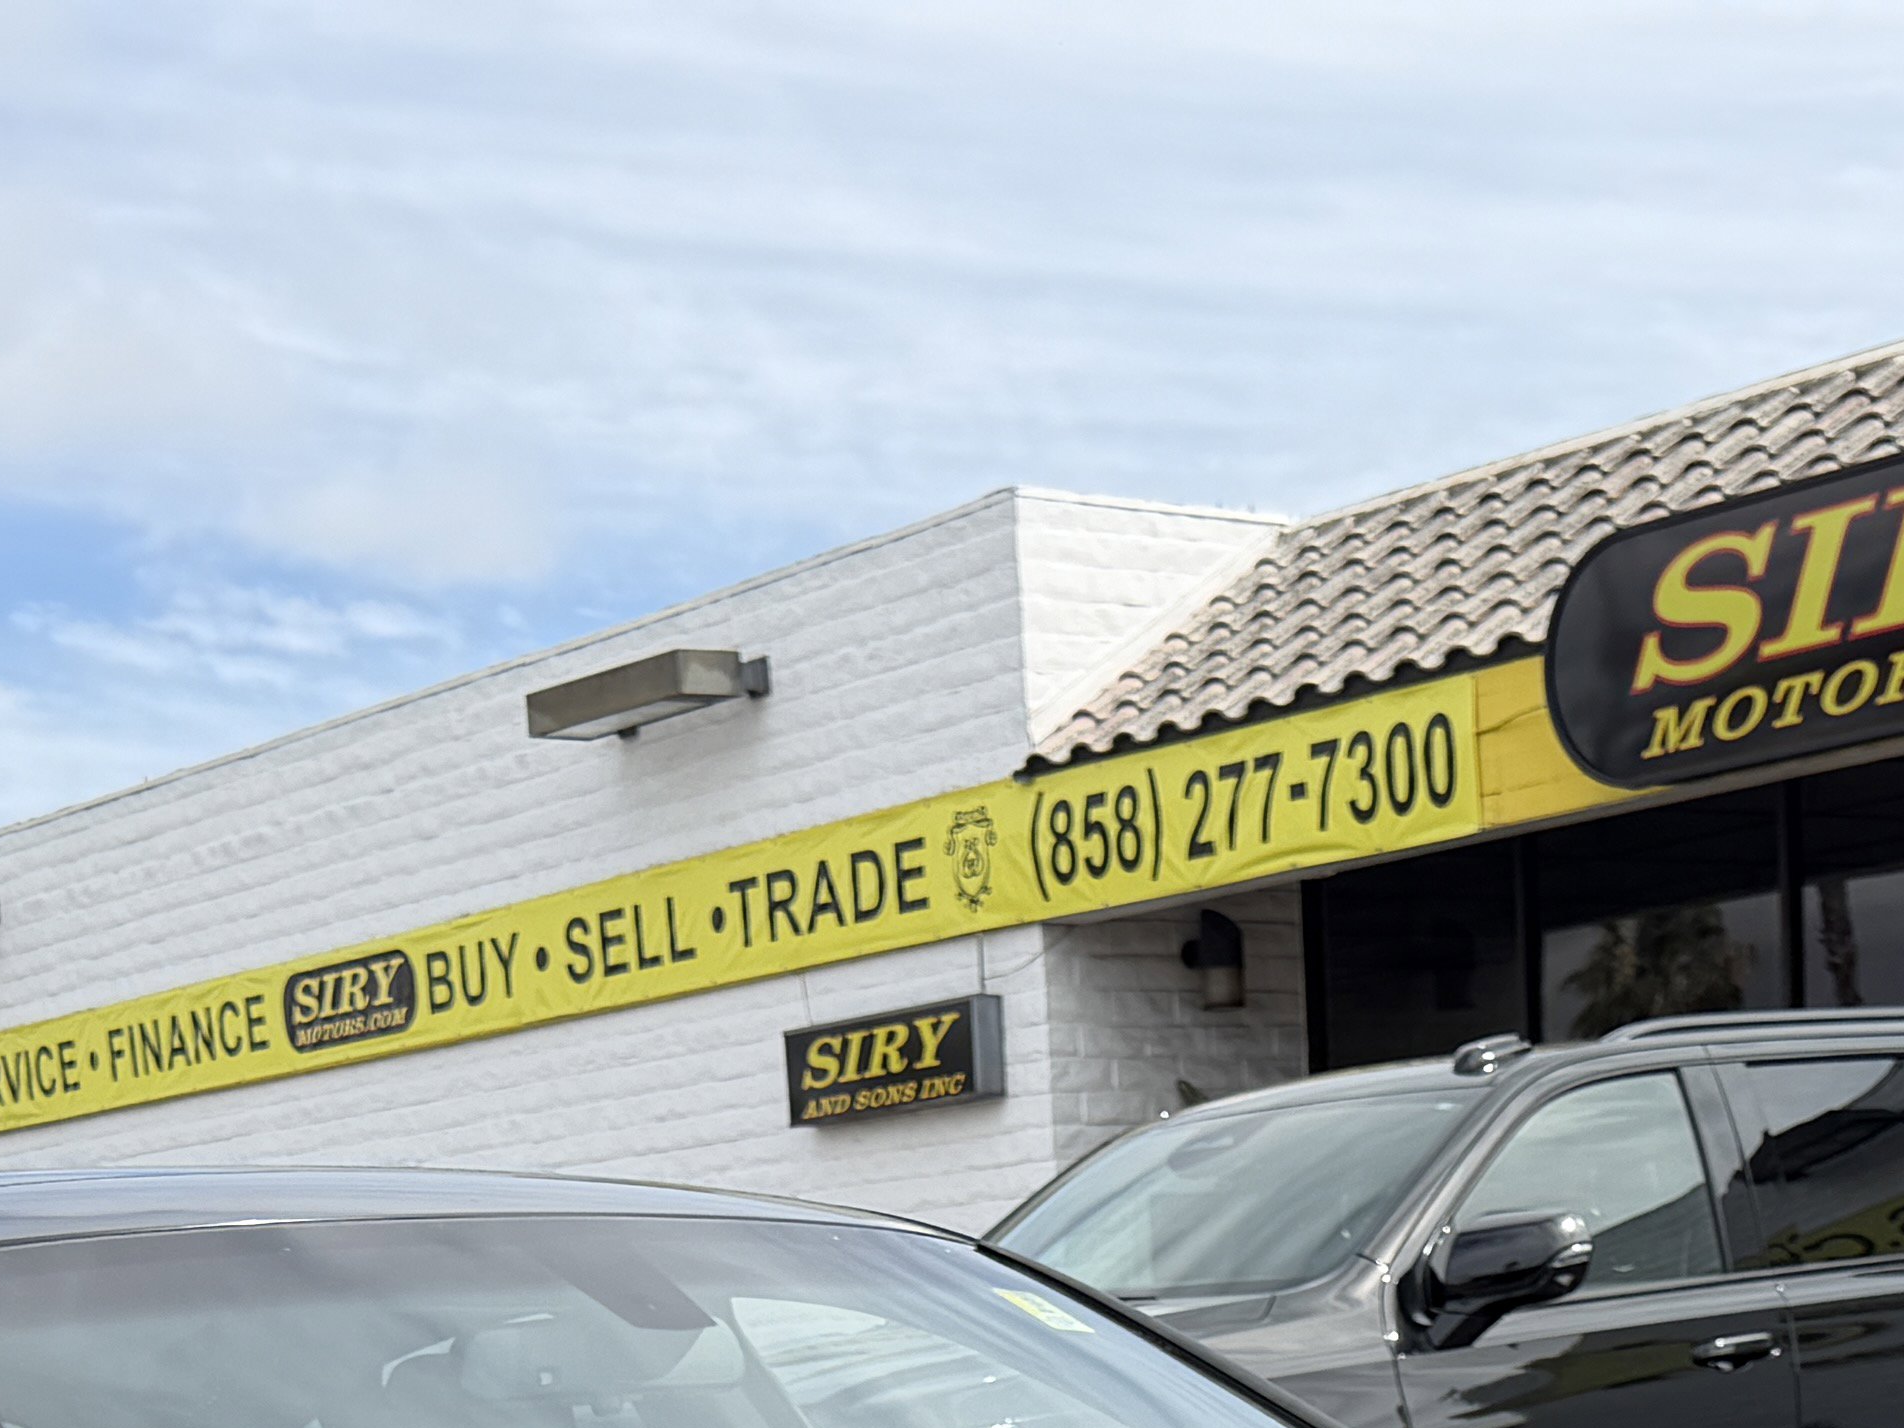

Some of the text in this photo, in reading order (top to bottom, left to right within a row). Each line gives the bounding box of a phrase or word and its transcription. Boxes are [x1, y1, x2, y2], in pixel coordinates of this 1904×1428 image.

[1031, 713, 1456, 902] (858) 277-7300
[427, 837, 930, 1015] BUY SELL TRADE
[292, 957, 406, 1026] SIRY
[298, 1007, 408, 1048] MOTORS.COM
[108, 993, 270, 1082] FINANCE
[801, 1011, 961, 1091] SIRY
[801, 1073, 967, 1120] AND SONS INC
